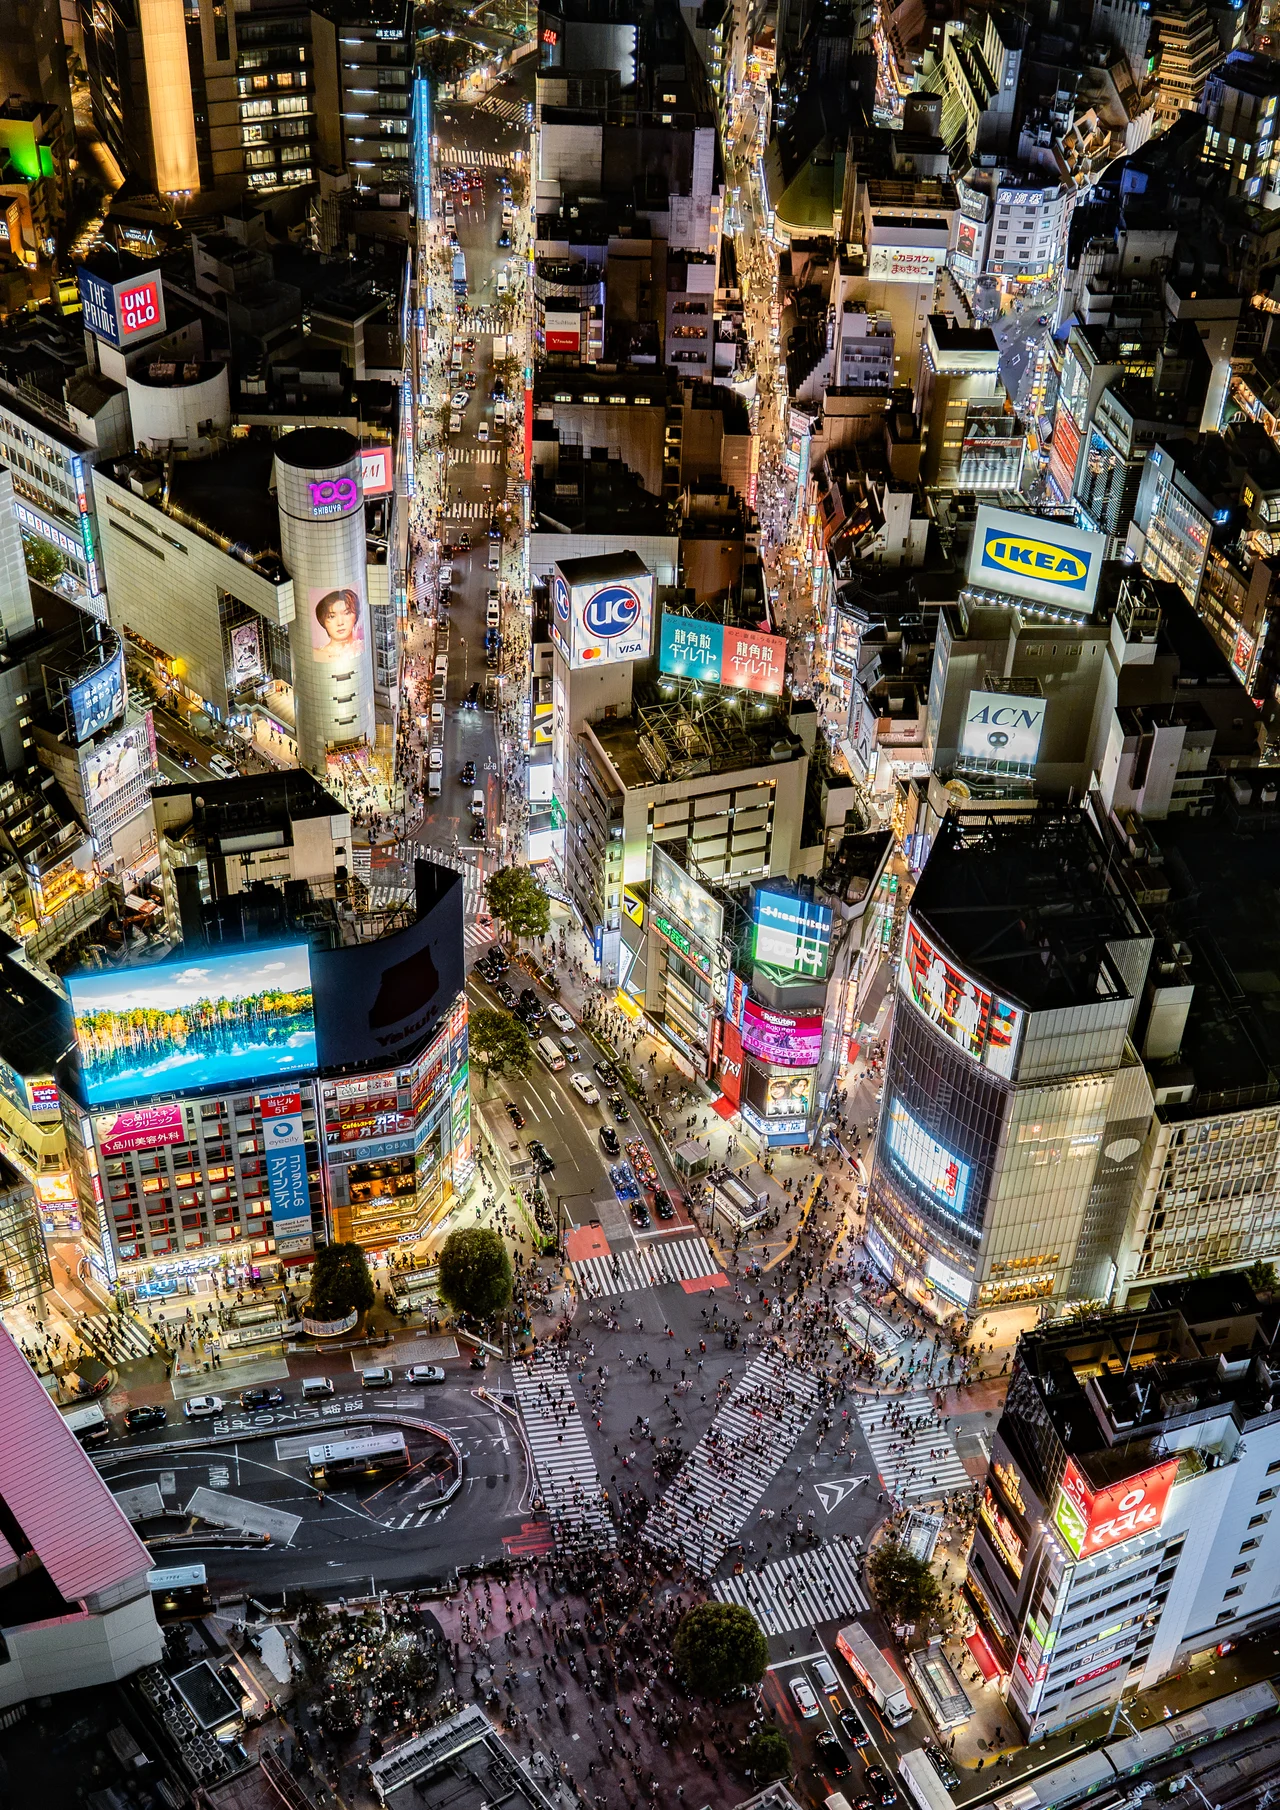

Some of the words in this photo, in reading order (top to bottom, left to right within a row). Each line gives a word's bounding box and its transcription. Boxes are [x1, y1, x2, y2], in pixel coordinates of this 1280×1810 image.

[898, 254, 929, 262] カラオケ
[891, 264, 928, 275] まねきねこ
[88, 279, 107, 310] THE
[124, 289, 151, 311] UNI
[84, 299, 116, 337] PRIME
[127, 305, 155, 328] QLO
[308, 477, 357, 511] 109
[313, 503, 342, 516] SHIBUYA
[994, 542, 1079, 577] IKEA
[618, 643, 642, 654] VISA
[674, 628, 711, 651] 龍角散
[668, 643, 716, 665] ダイレクト
[736, 640, 774, 662] 龍角散
[730, 655, 779, 677] ダイレクト
[968, 705, 1042, 729] ACN
[760, 905, 830, 932] Hisamitsu
[763, 1012, 796, 1027] Rakuten
[765, 1023, 796, 1034] Rakuten
[267, 1097, 294, 1108] 当ビル
[324, 1089, 336, 1097] 9F
[133, 1108, 177, 1122] 品川スキン
[275, 1105, 289, 1114] 5F
[377, 1113, 404, 1125] ガスト
[135, 1116, 173, 1129] クリニック
[359, 1124, 393, 1137] ガスト
[112, 1130, 180, 1150] 品川美容外科
[269, 1136, 299, 1146] eyecity
[1101, 1165, 1134, 1175] TSUTAYA
[271, 1157, 291, 1209] アイシティ
[290, 1154, 305, 1207] コンタクトの
[154, 1254, 220, 1275] サンドラッグ
[1092, 1503, 1157, 1544] アコム
